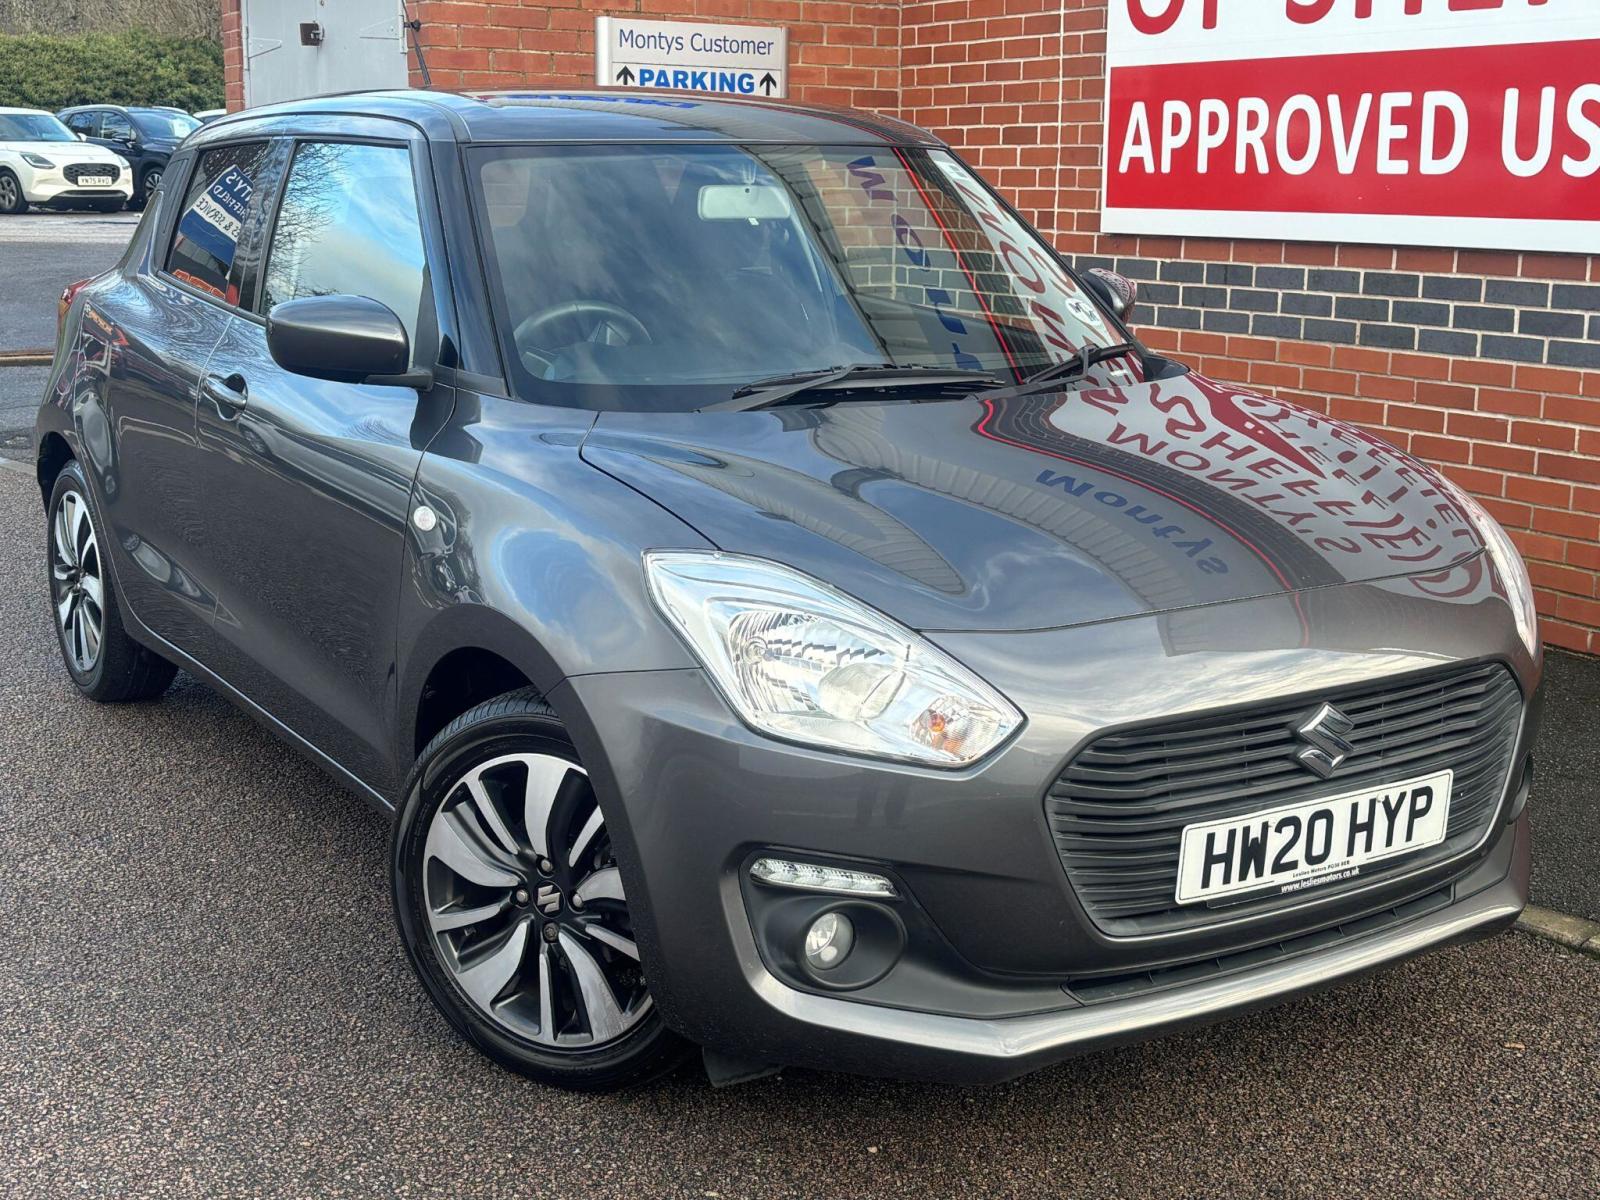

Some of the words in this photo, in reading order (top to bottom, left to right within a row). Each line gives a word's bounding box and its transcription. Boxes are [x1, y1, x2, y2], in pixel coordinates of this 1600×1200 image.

[618, 28, 684, 55] Montys
[690, 32, 774, 56] Customer
[639, 68, 755, 94] PARKING
[1118, 90, 1469, 176] APPROVED
[1200, 808, 1334, 890] HW20
[1346, 785, 1434, 857] HYP
[1280, 866, 1361, 893] www.lesliesmotors.co.uk
